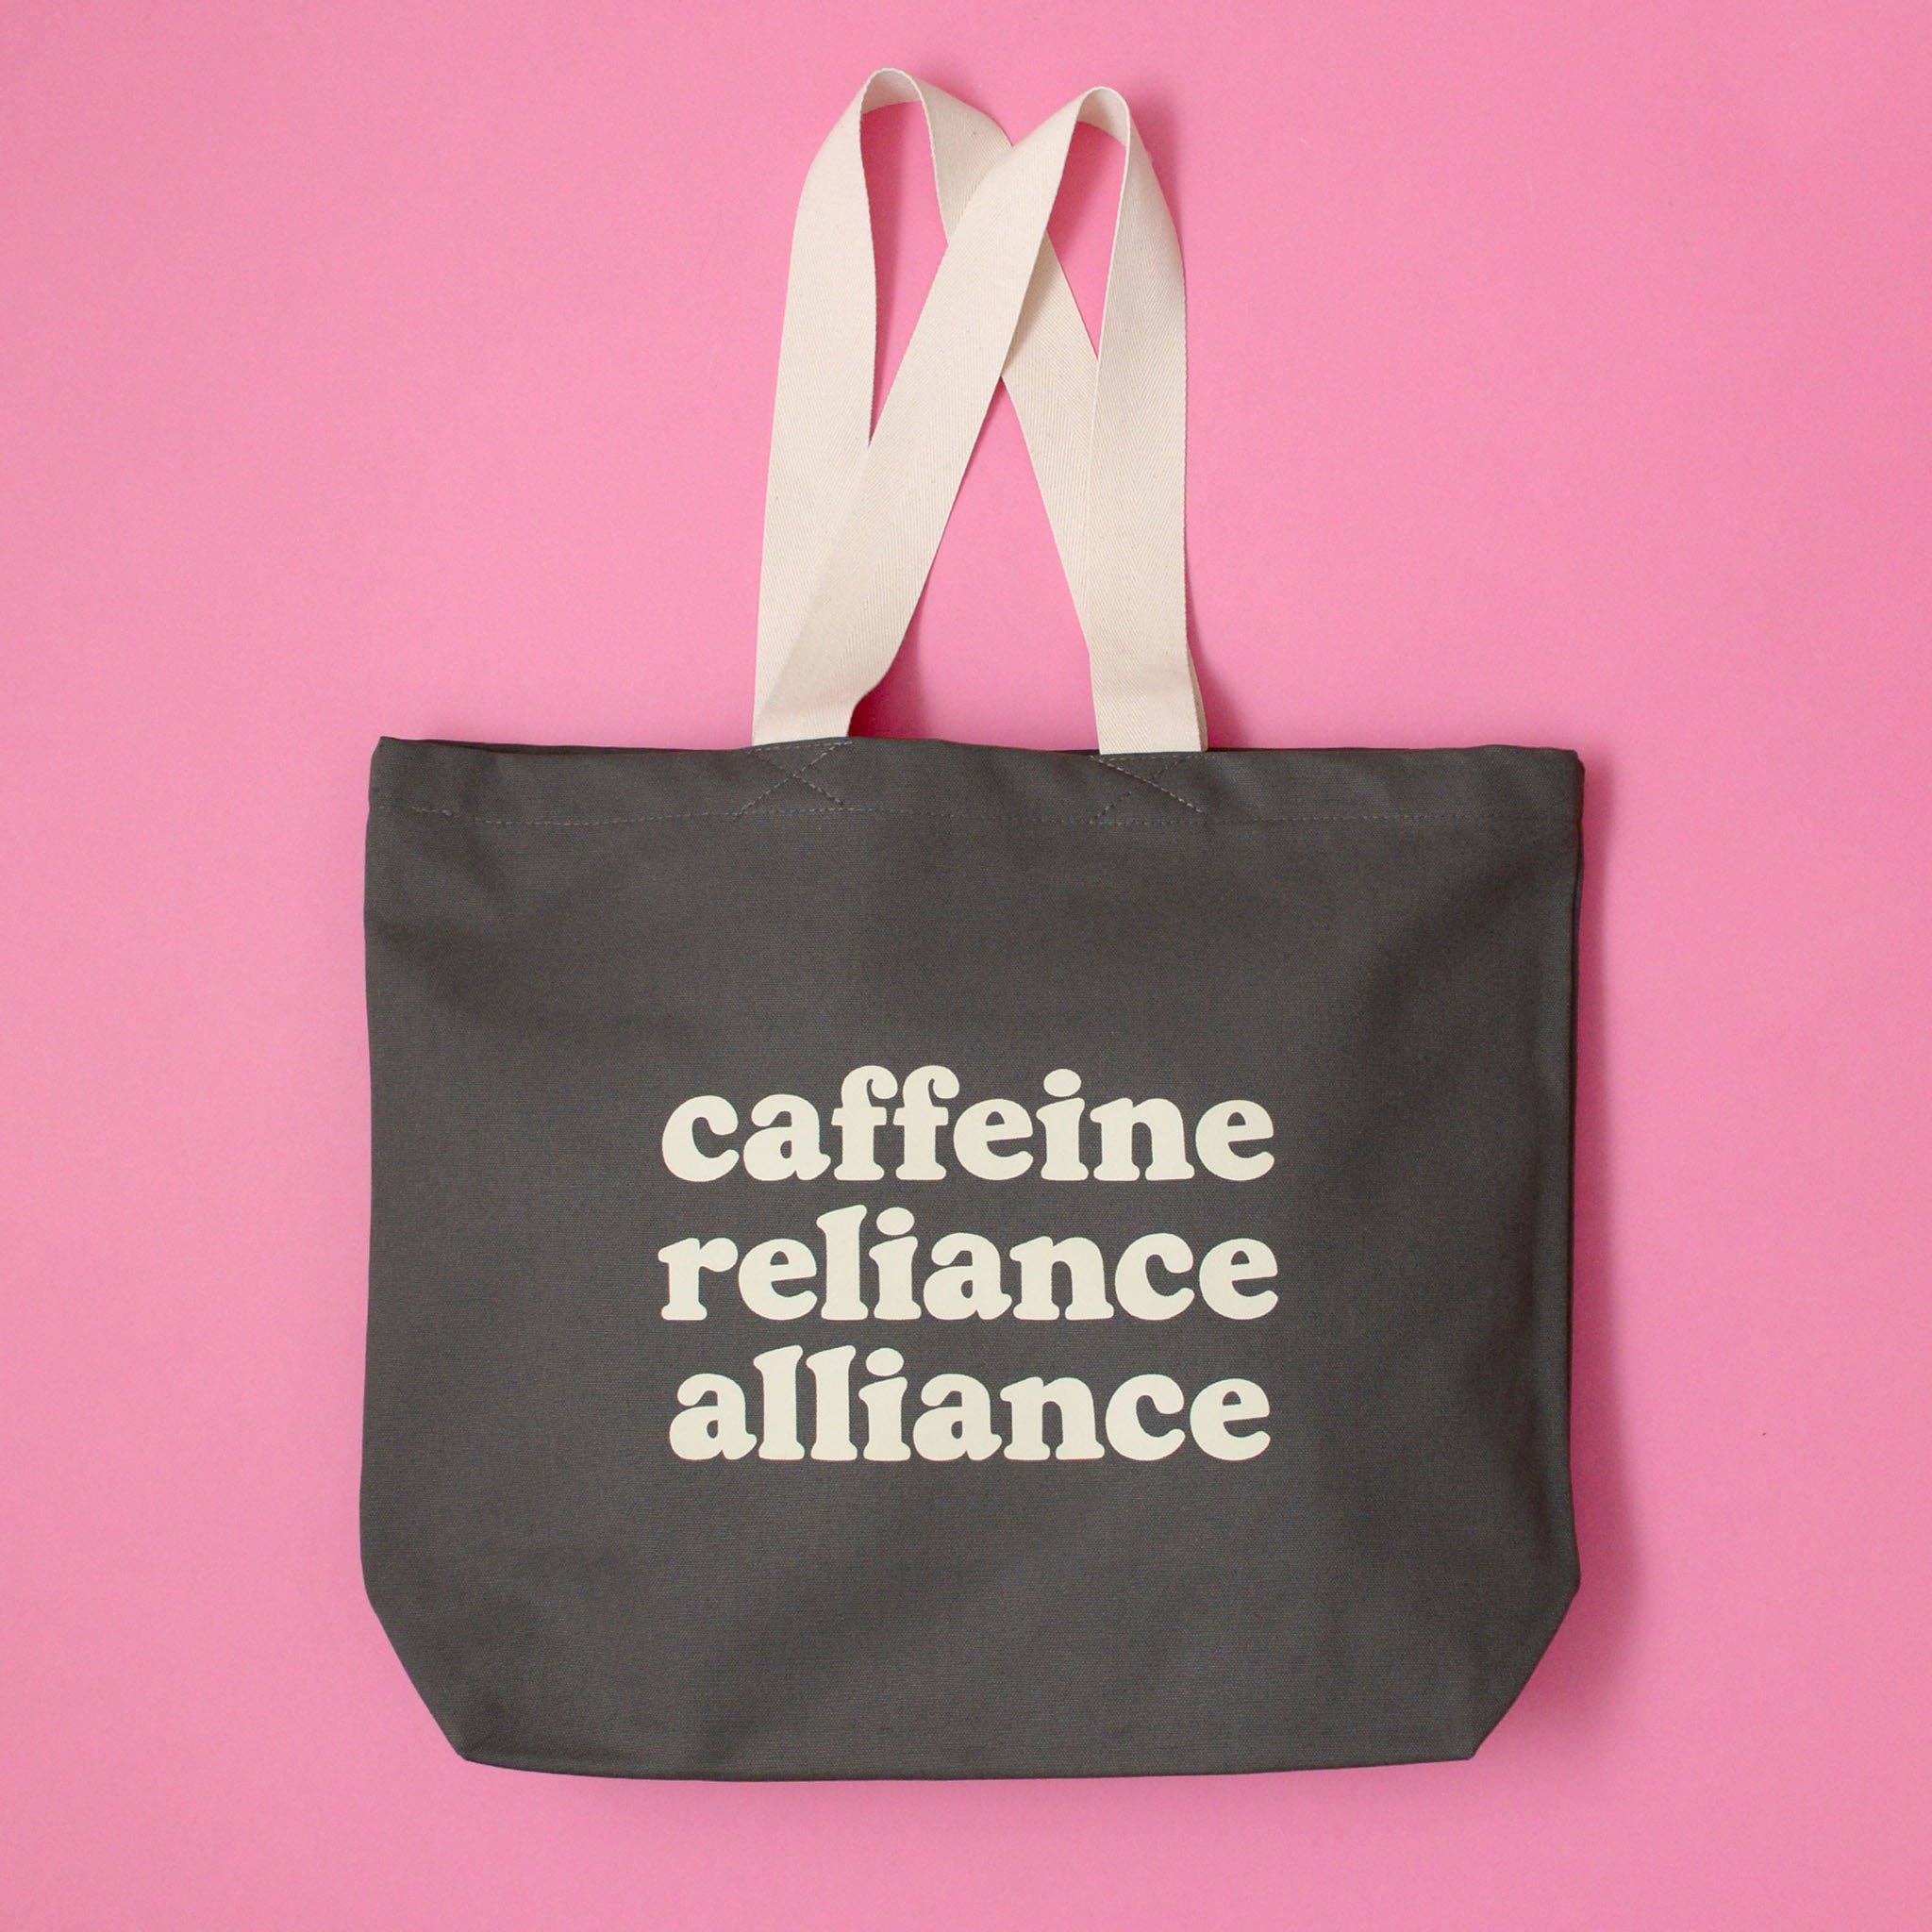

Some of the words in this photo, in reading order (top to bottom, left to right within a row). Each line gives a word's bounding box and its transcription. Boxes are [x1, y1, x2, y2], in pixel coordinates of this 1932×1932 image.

[661, 1064, 1274, 1182] caffeine
[658, 1204, 1279, 1321] reliance
[669, 1344, 1271, 1461] alliance
